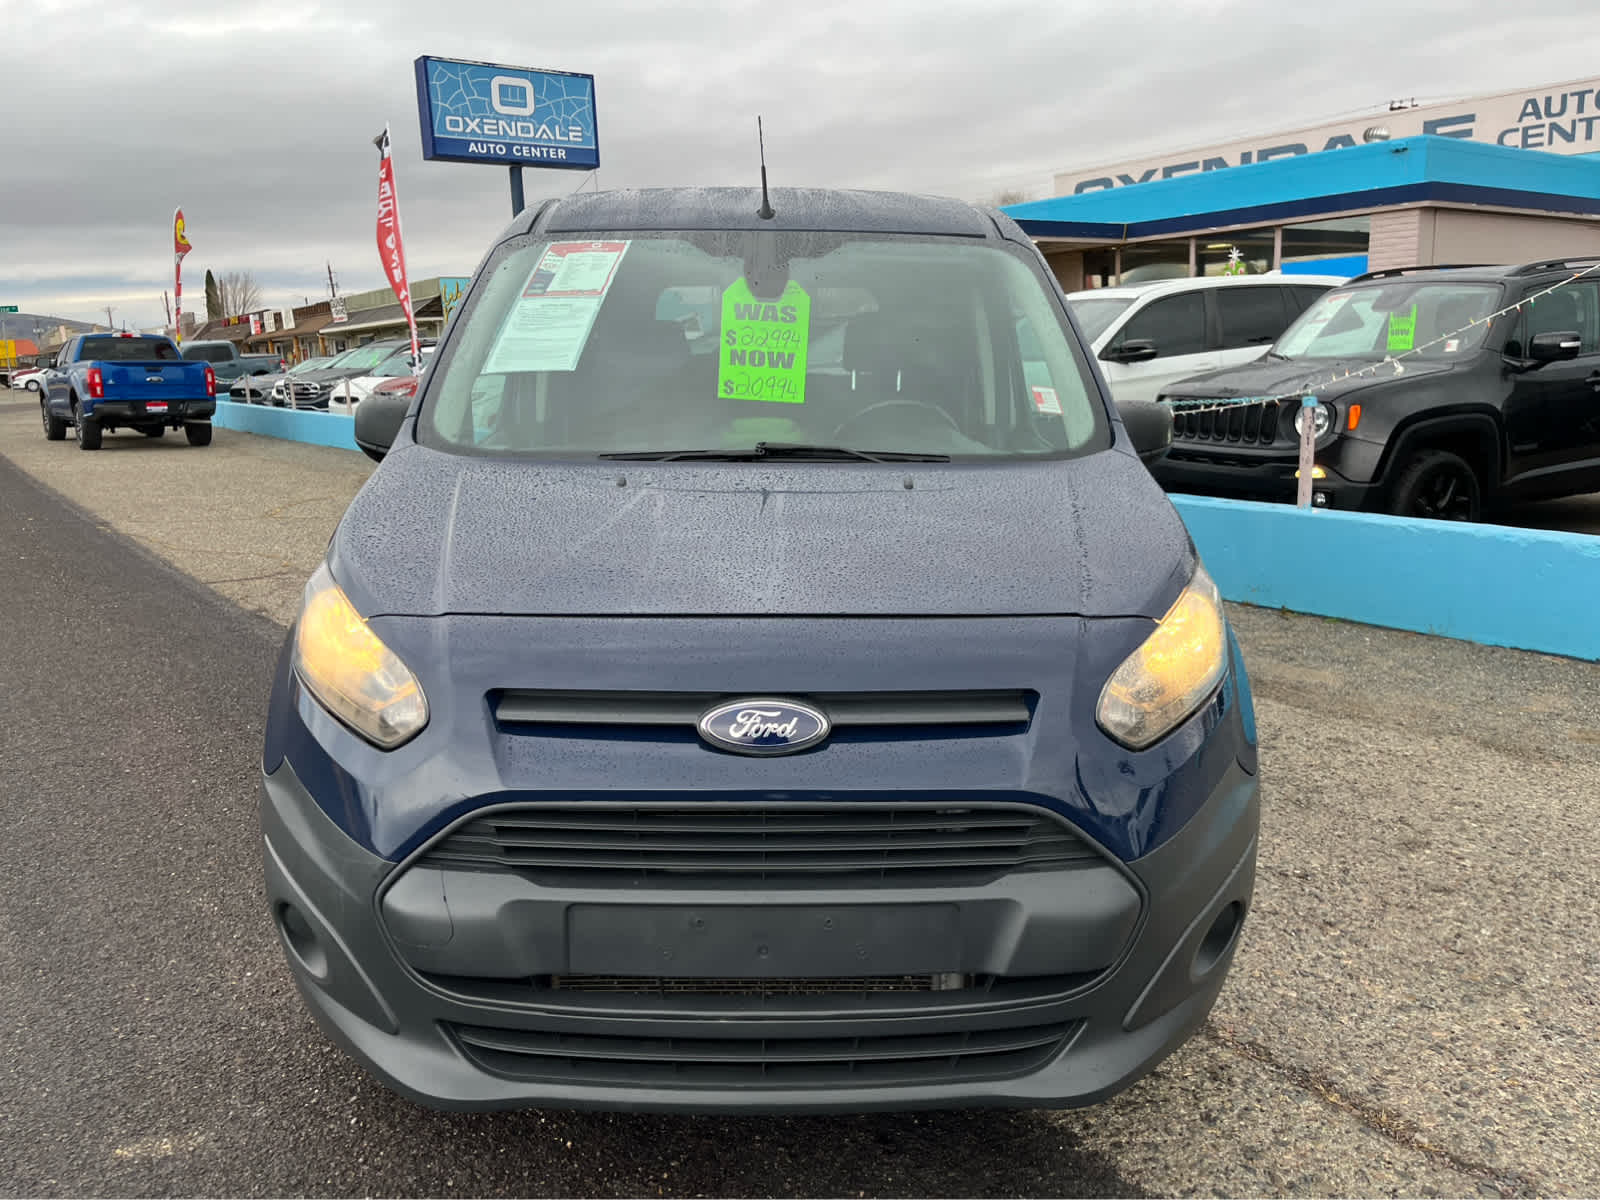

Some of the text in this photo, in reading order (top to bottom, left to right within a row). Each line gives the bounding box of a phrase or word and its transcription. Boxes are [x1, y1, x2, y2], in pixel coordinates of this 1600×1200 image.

[1517, 88, 1600, 123] AUT
[445, 115, 583, 142] OXENDALE
[468, 142, 567, 160] AUTO CENTER
[734, 303, 797, 324] WAS
[730, 349, 796, 369] NOW
[729, 709, 799, 738] Ford
